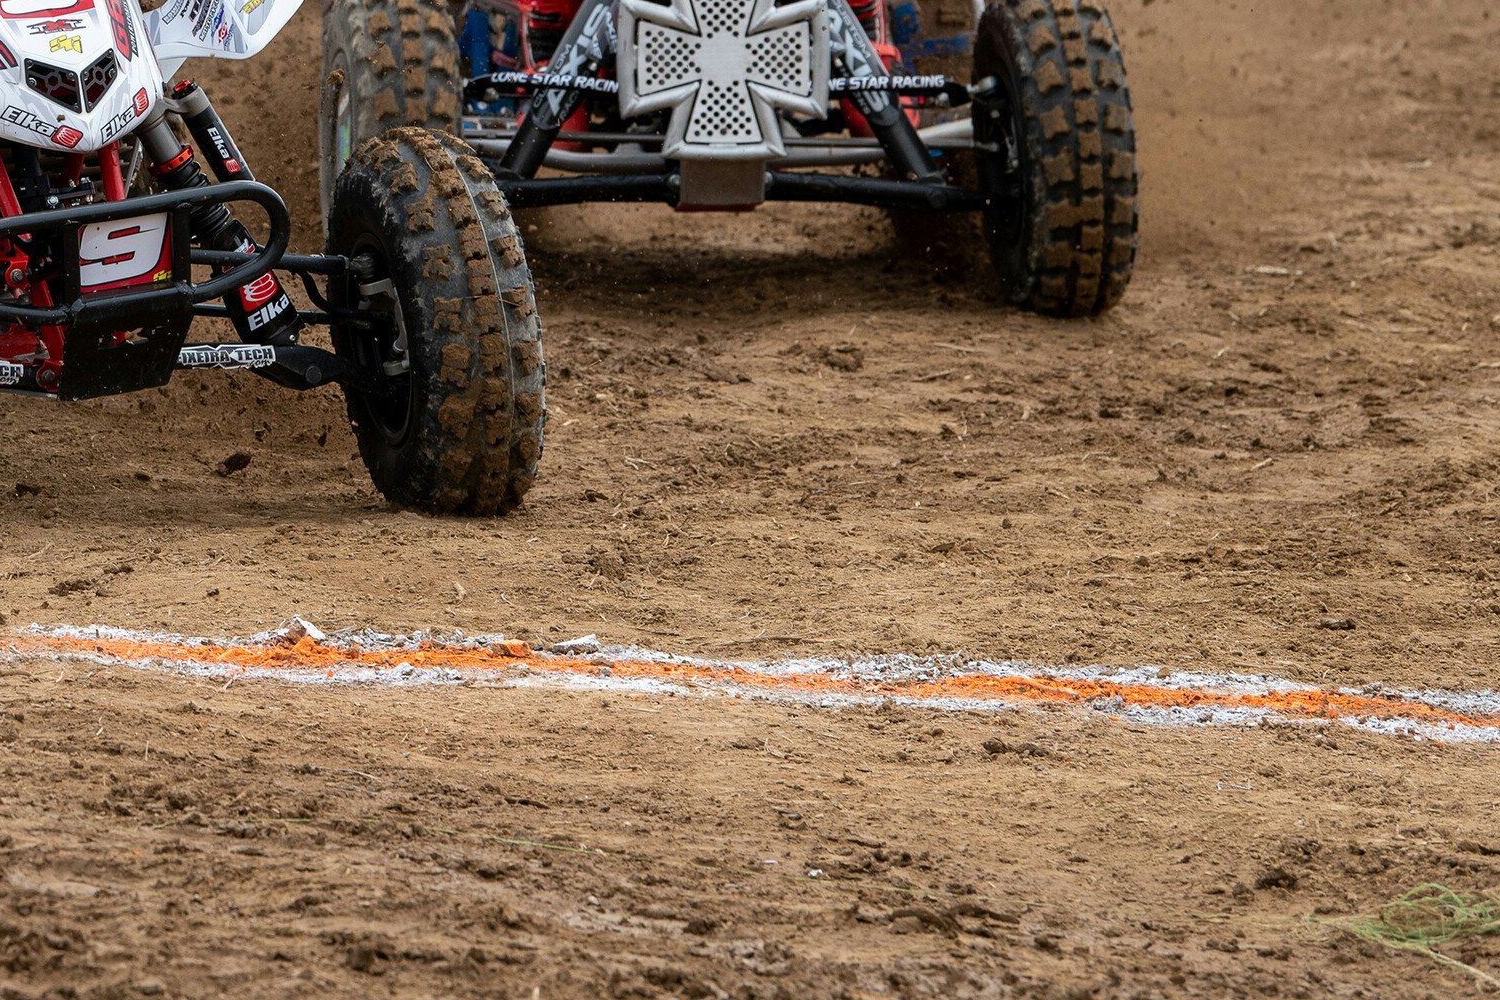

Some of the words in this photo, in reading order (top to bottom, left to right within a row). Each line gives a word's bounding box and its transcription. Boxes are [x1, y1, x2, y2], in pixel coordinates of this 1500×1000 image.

[491, 72, 528, 83] LONE
[531, 73, 572, 87] STAR
[574, 76, 619, 93] RACIN
[849, 76, 889, 89] STAR
[892, 75, 945, 88] RACING
[0, 106, 56, 137] Elka
[101, 107, 137, 145] Elka
[207, 126, 231, 158] Elka
[247, 293, 291, 332] Elka
[179, 350, 230, 365] IXEIRA
[235, 348, 273, 361] TECH
